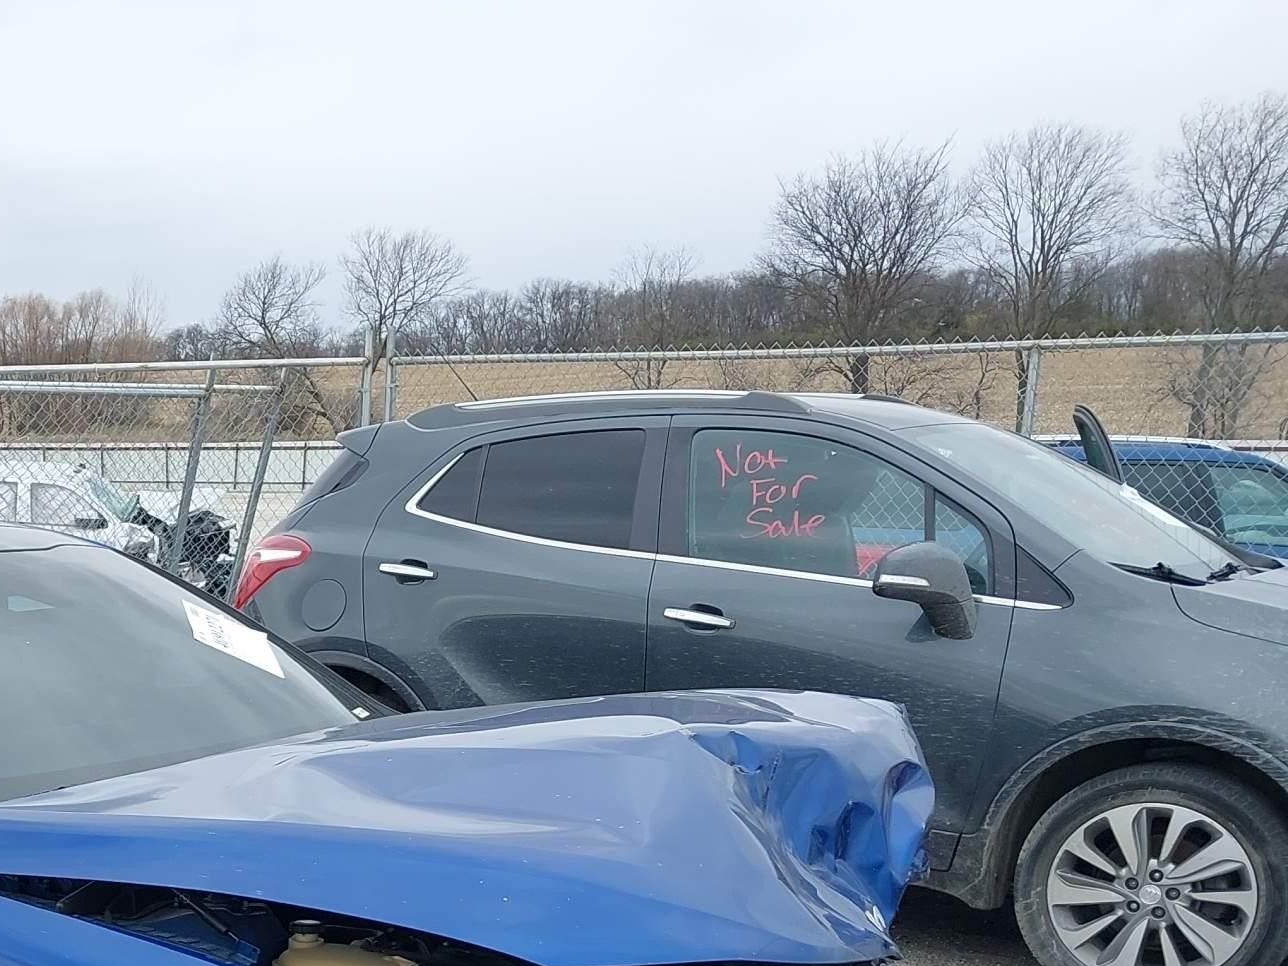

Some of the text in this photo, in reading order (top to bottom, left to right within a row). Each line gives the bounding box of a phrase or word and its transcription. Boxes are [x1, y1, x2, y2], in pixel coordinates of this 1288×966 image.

[715, 443, 788, 488] Not
[750, 474, 819, 505] For
[741, 507, 826, 538] Sale
